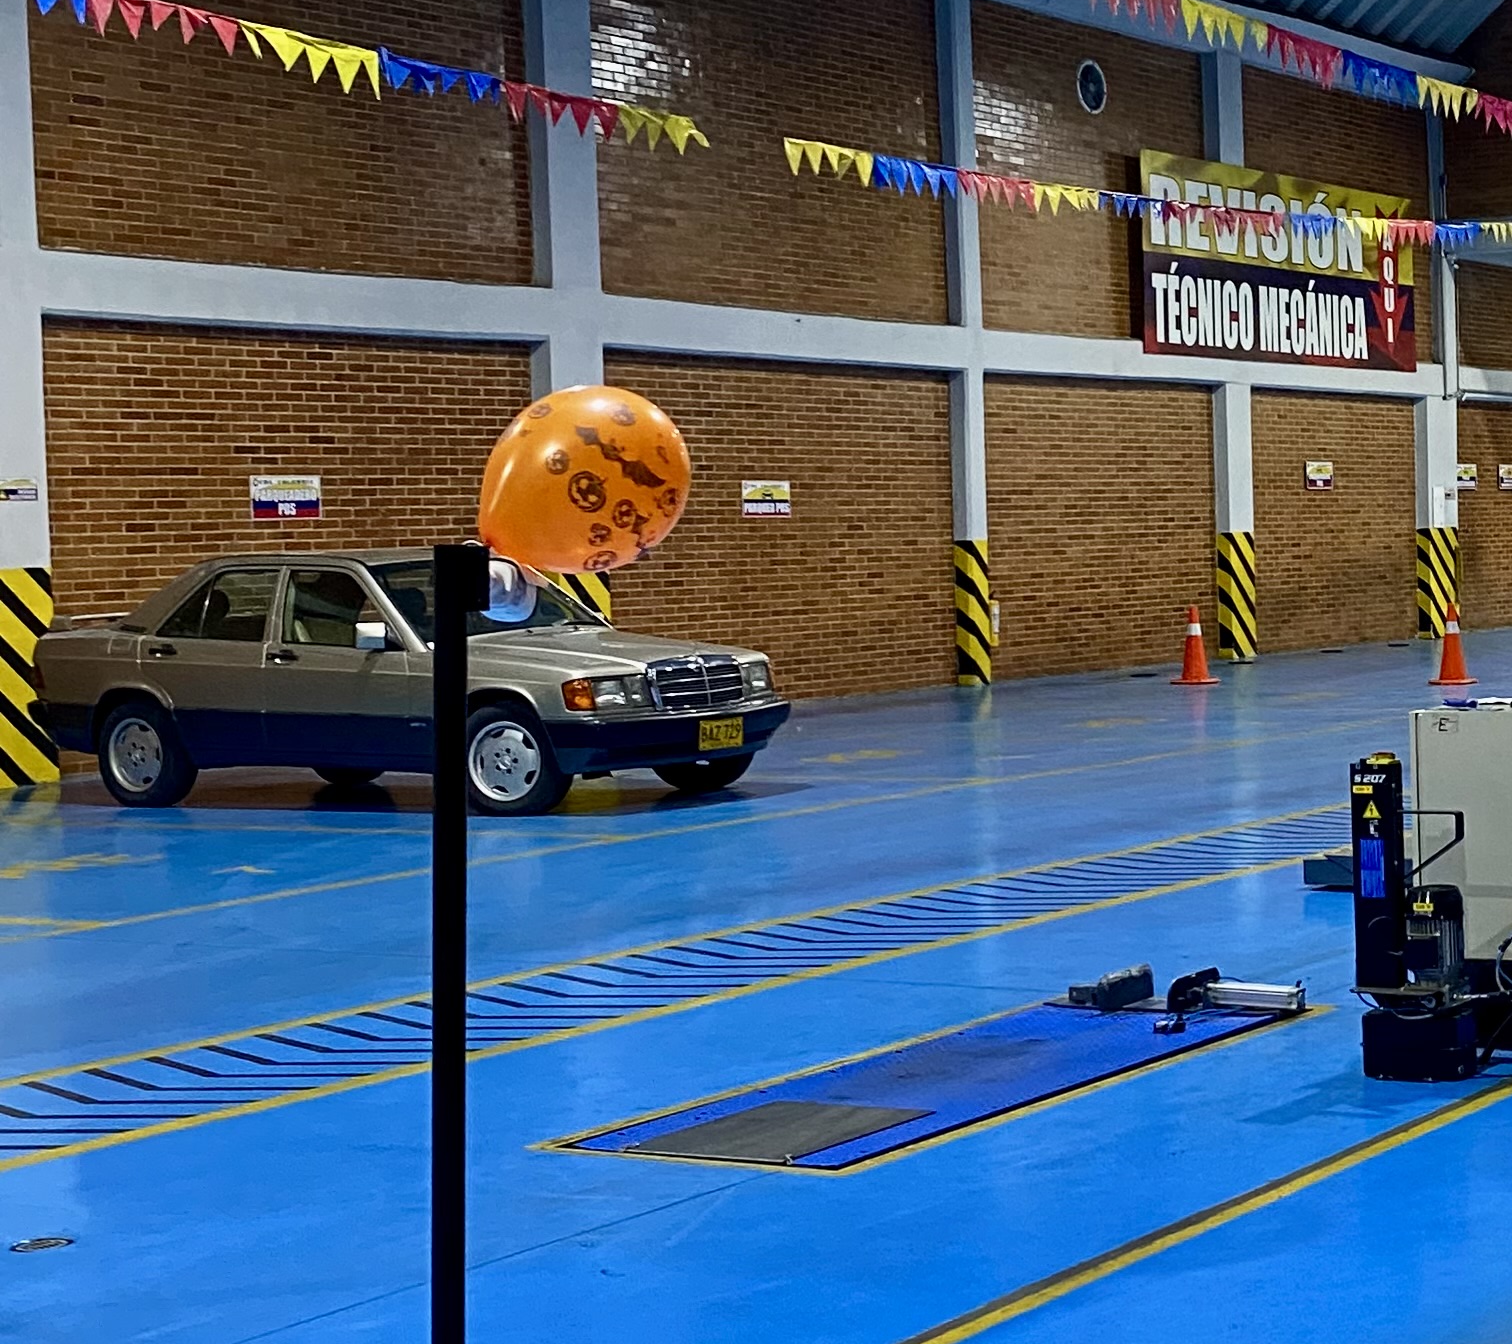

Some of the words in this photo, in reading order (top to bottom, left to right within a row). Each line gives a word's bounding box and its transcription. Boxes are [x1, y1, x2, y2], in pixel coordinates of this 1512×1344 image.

[1149, 173, 1364, 273] REVISIÓN
[1151, 261, 1255, 352] TÉCNICO
[1258, 279, 1370, 360] MECÁNICA
[1362, 773, 1387, 783] 207
